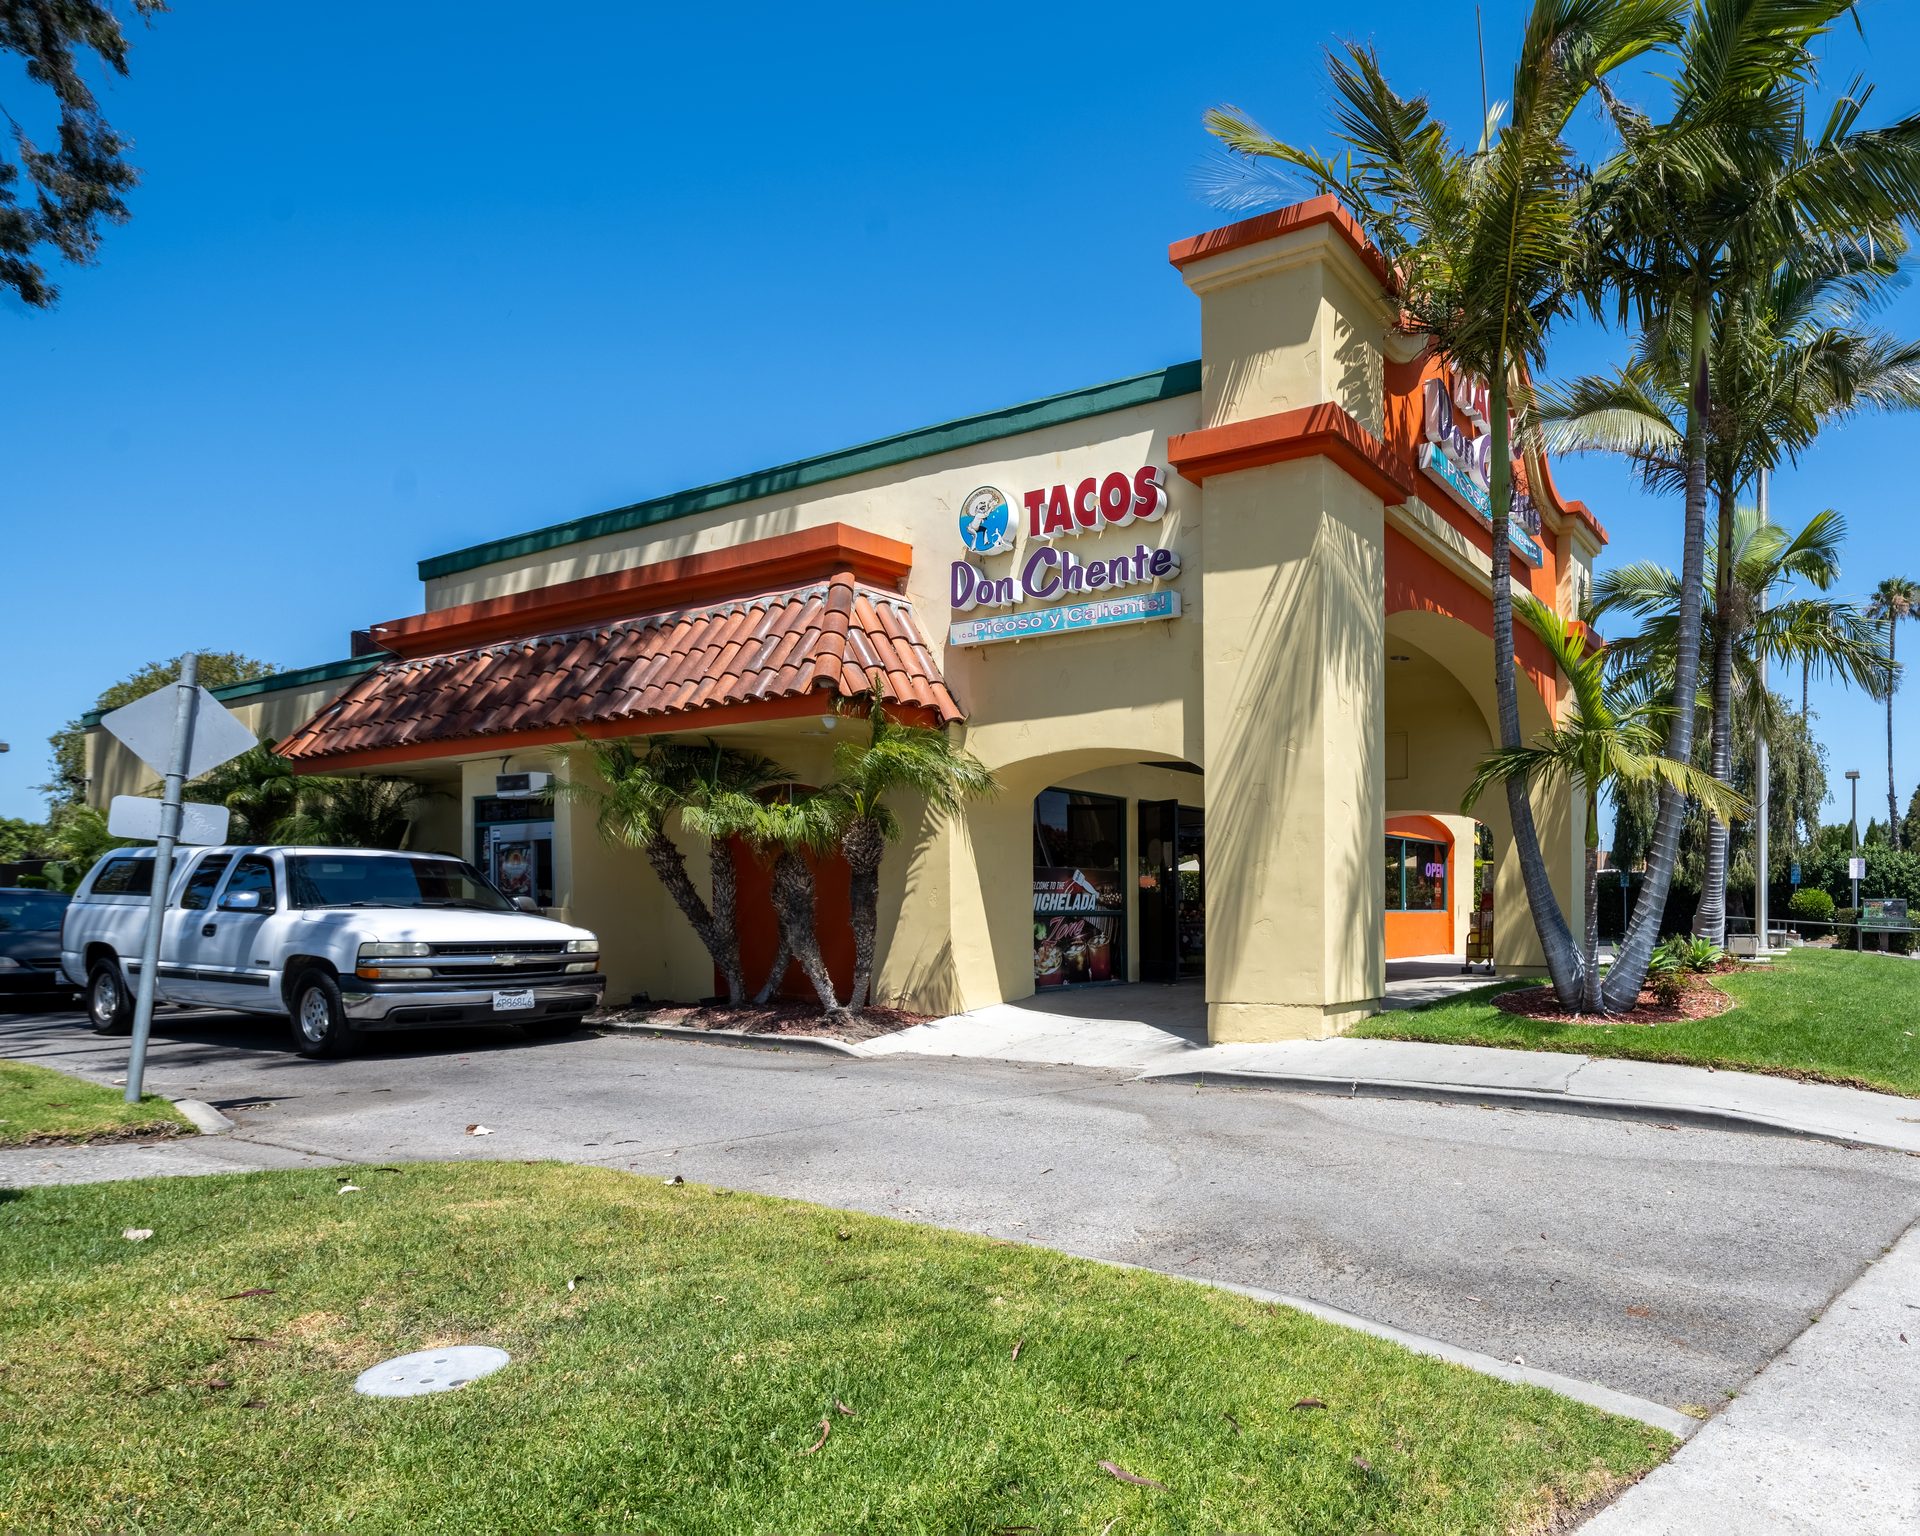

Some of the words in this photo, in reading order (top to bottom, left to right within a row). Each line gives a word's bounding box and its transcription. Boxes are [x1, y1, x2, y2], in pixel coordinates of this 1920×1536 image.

[1024, 465, 1162, 537] TACOS
[951, 560, 1016, 610] Don
[1021, 544, 1173, 599] Chente
[1049, 614, 1061, 628] y
[1068, 595, 1166, 622] Caliente!
[1425, 862, 1444, 878] OPEN
